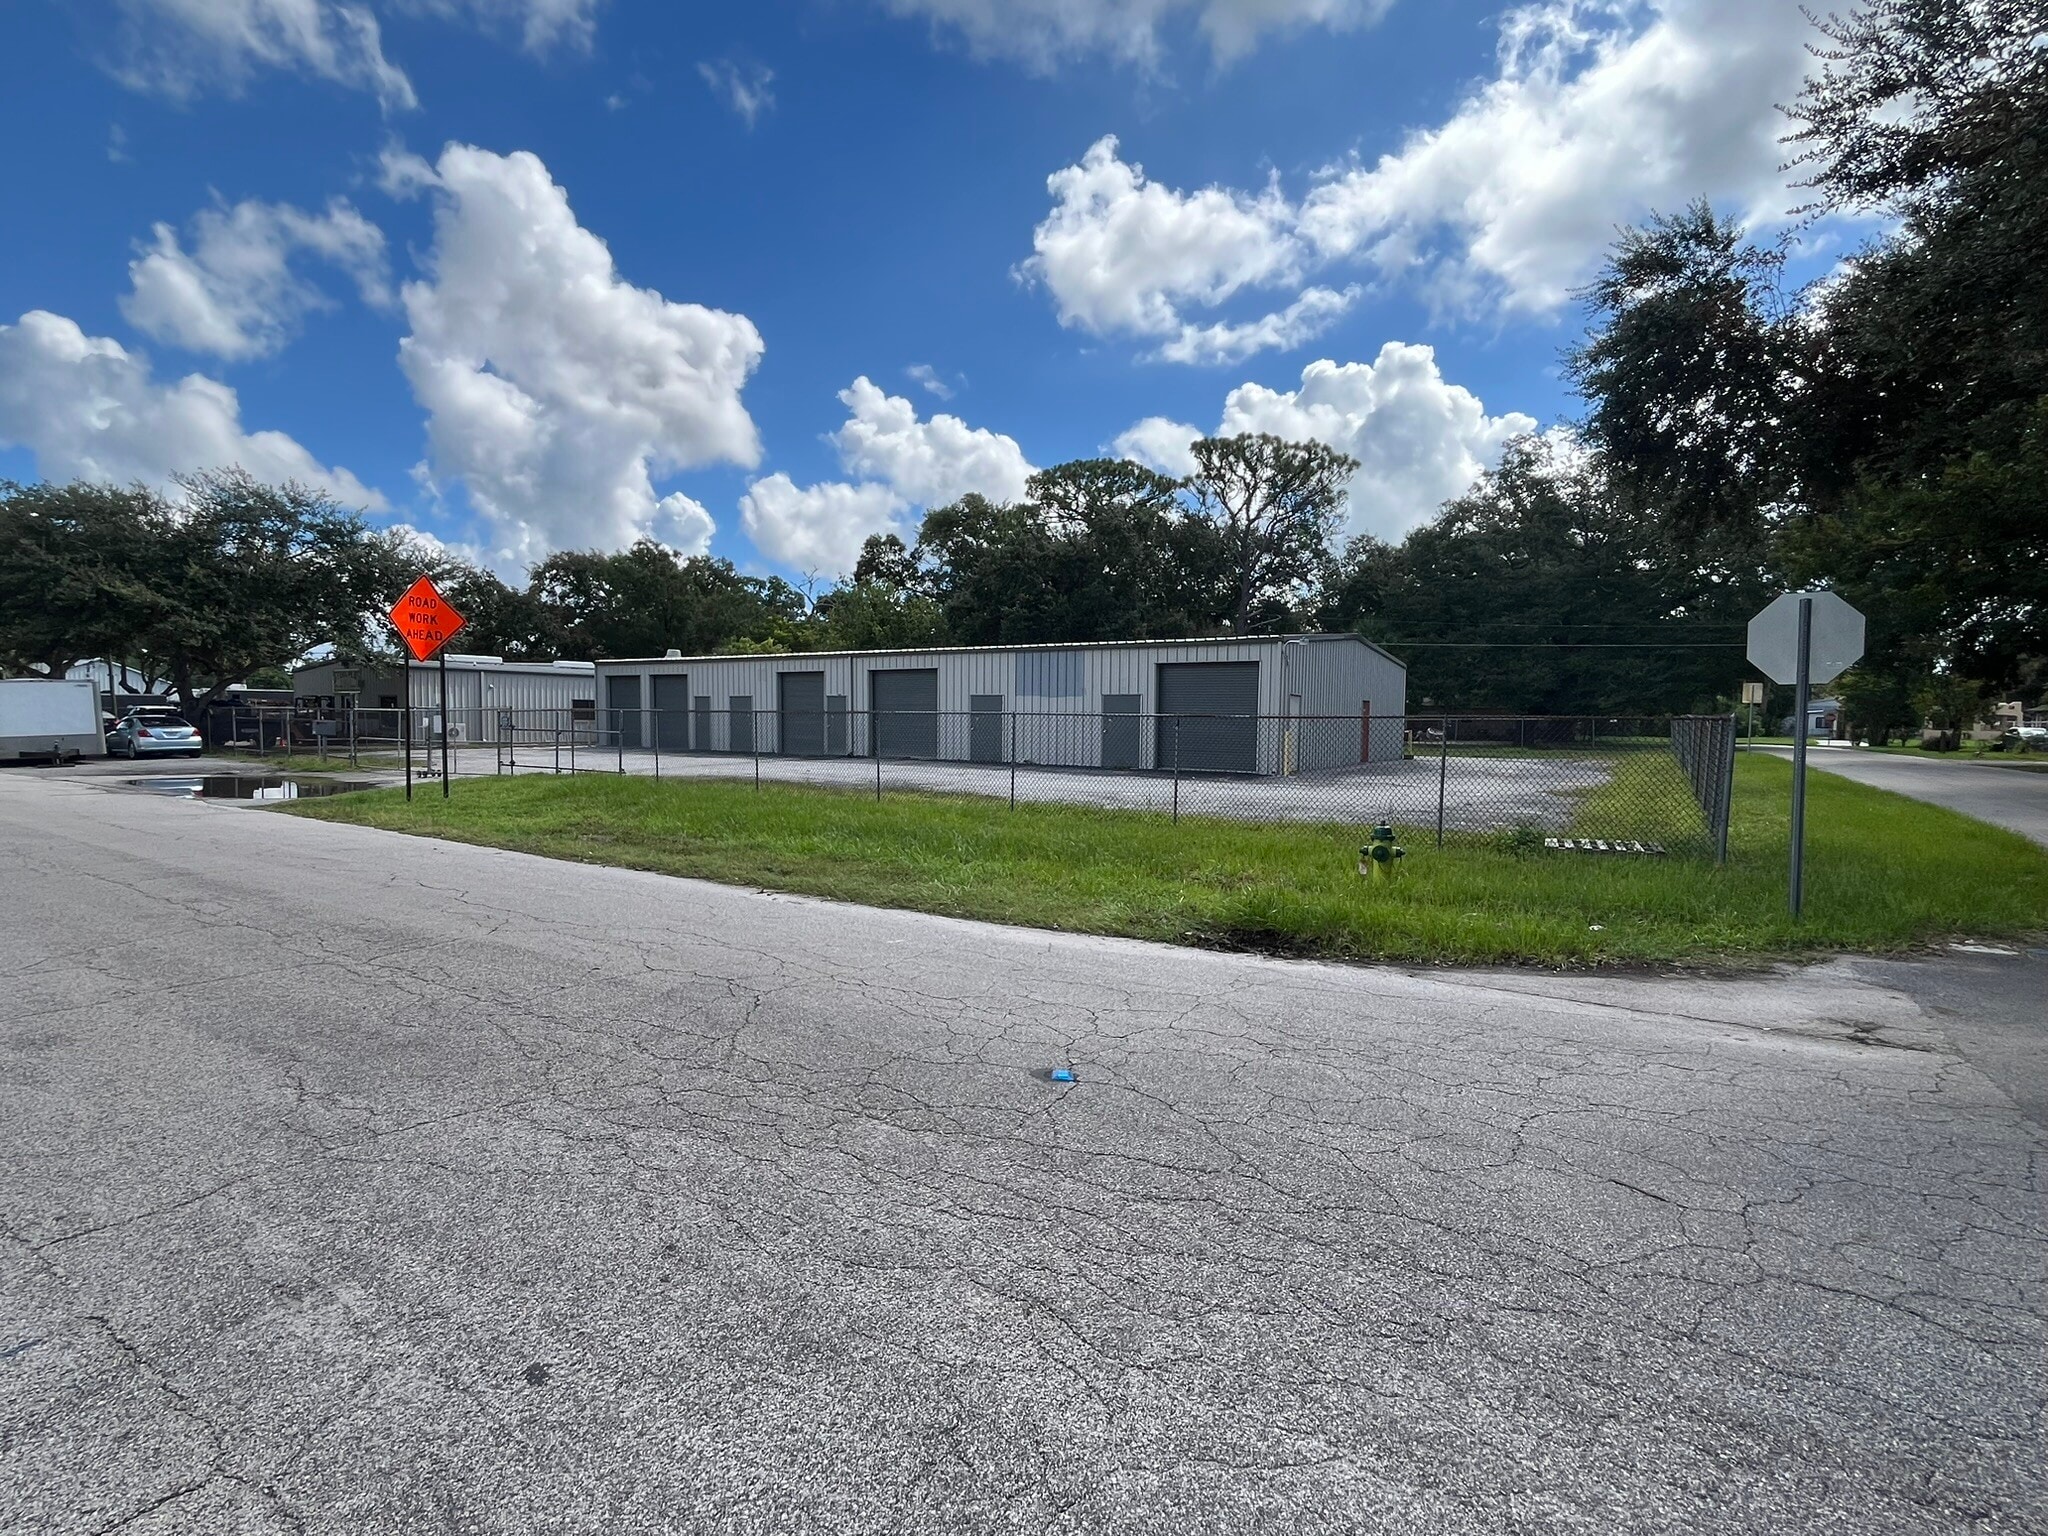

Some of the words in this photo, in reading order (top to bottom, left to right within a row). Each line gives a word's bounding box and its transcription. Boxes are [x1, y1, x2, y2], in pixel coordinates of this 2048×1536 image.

[409, 596, 437, 609] ROAD
[409, 613, 438, 625] WORK
[407, 629, 443, 640] AHEAD
